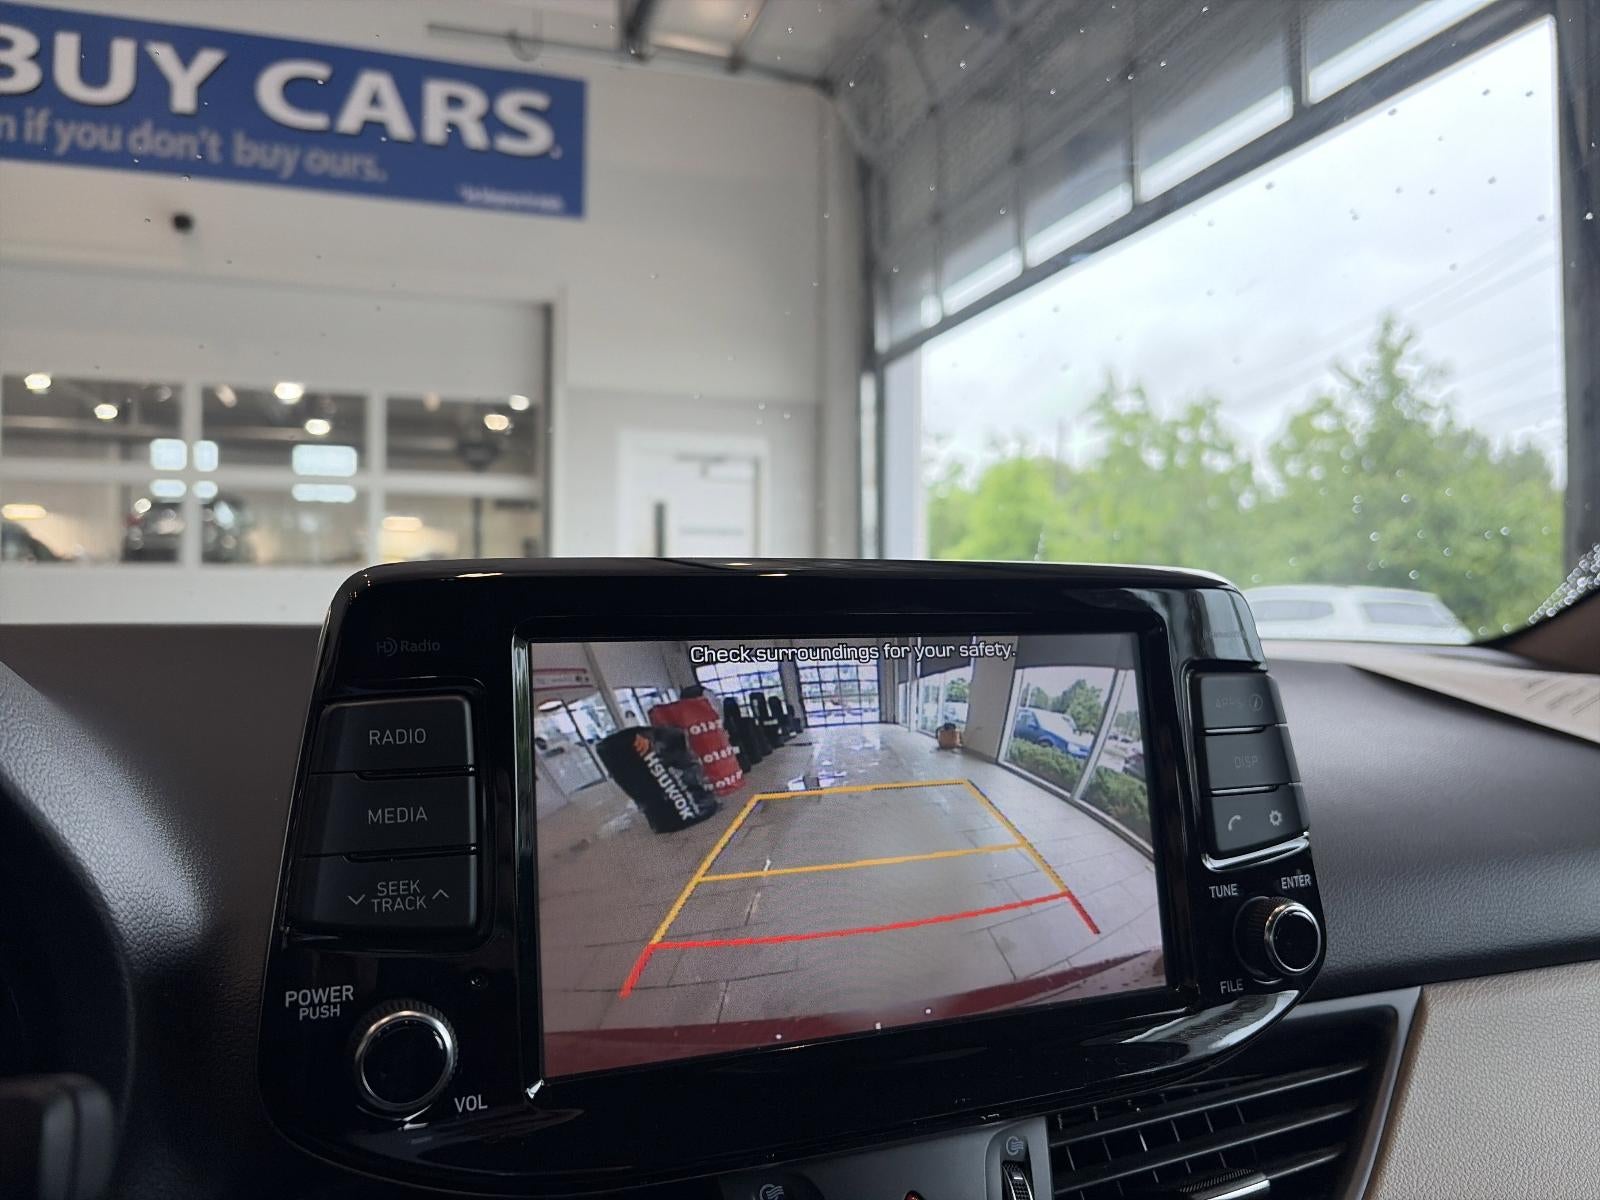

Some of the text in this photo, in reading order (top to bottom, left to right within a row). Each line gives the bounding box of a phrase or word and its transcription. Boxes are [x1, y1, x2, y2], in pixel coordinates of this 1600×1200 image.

[0, 23, 227, 116] BUY
[55, 119, 122, 156] you
[233, 130, 298, 179] buy
[400, 639, 441, 653] Radio
[690, 642, 1017, 663] Check surroundings for your safety.
[369, 728, 427, 745] RADIO
[367, 806, 428, 825] MEDIA
[377, 879, 421, 896] SEEK
[1281, 873, 1312, 889] ENTER
[1209, 883, 1239, 899] TUNE
[371, 896, 427, 913] TRACK
[1219, 978, 1245, 994] FILE
[285, 984, 354, 1008] POWER
[299, 1004, 341, 1021] PUSH
[454, 1094, 488, 1113] VOL
